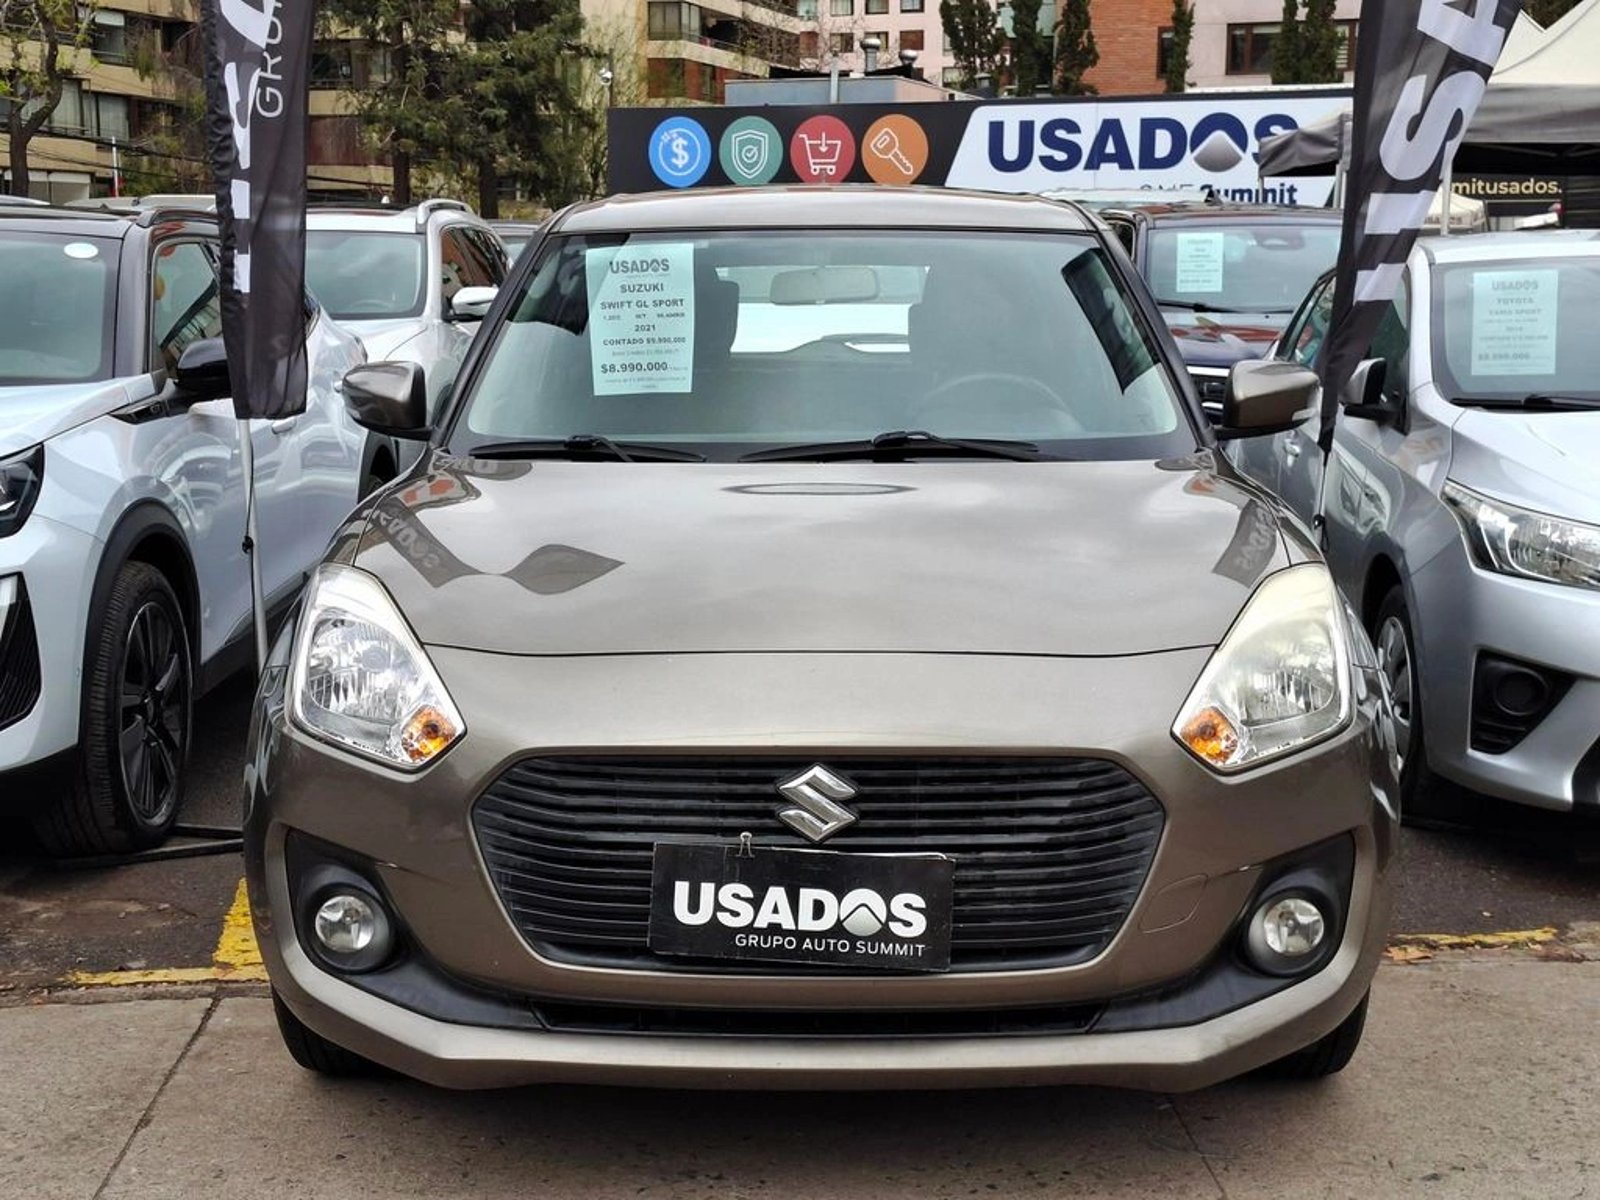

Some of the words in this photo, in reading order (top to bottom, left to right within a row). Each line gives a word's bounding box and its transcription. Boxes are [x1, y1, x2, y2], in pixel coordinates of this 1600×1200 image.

[609, 258, 670, 274] USADOS
[619, 282, 665, 294] SUZUKI
[599, 300, 632, 311] SWIFT
[635, 299, 649, 309] GL
[652, 298, 685, 308] SPORT
[634, 324, 656, 332] 2021
[602, 338, 644, 347] CONTADO
[600, 361, 668, 374] $8.990.000
[673, 881, 927, 938] USADOS
[735, 933, 797, 949] GRUPO
[802, 938, 850, 953] AUTO
[855, 940, 926, 957] SUMMIT
